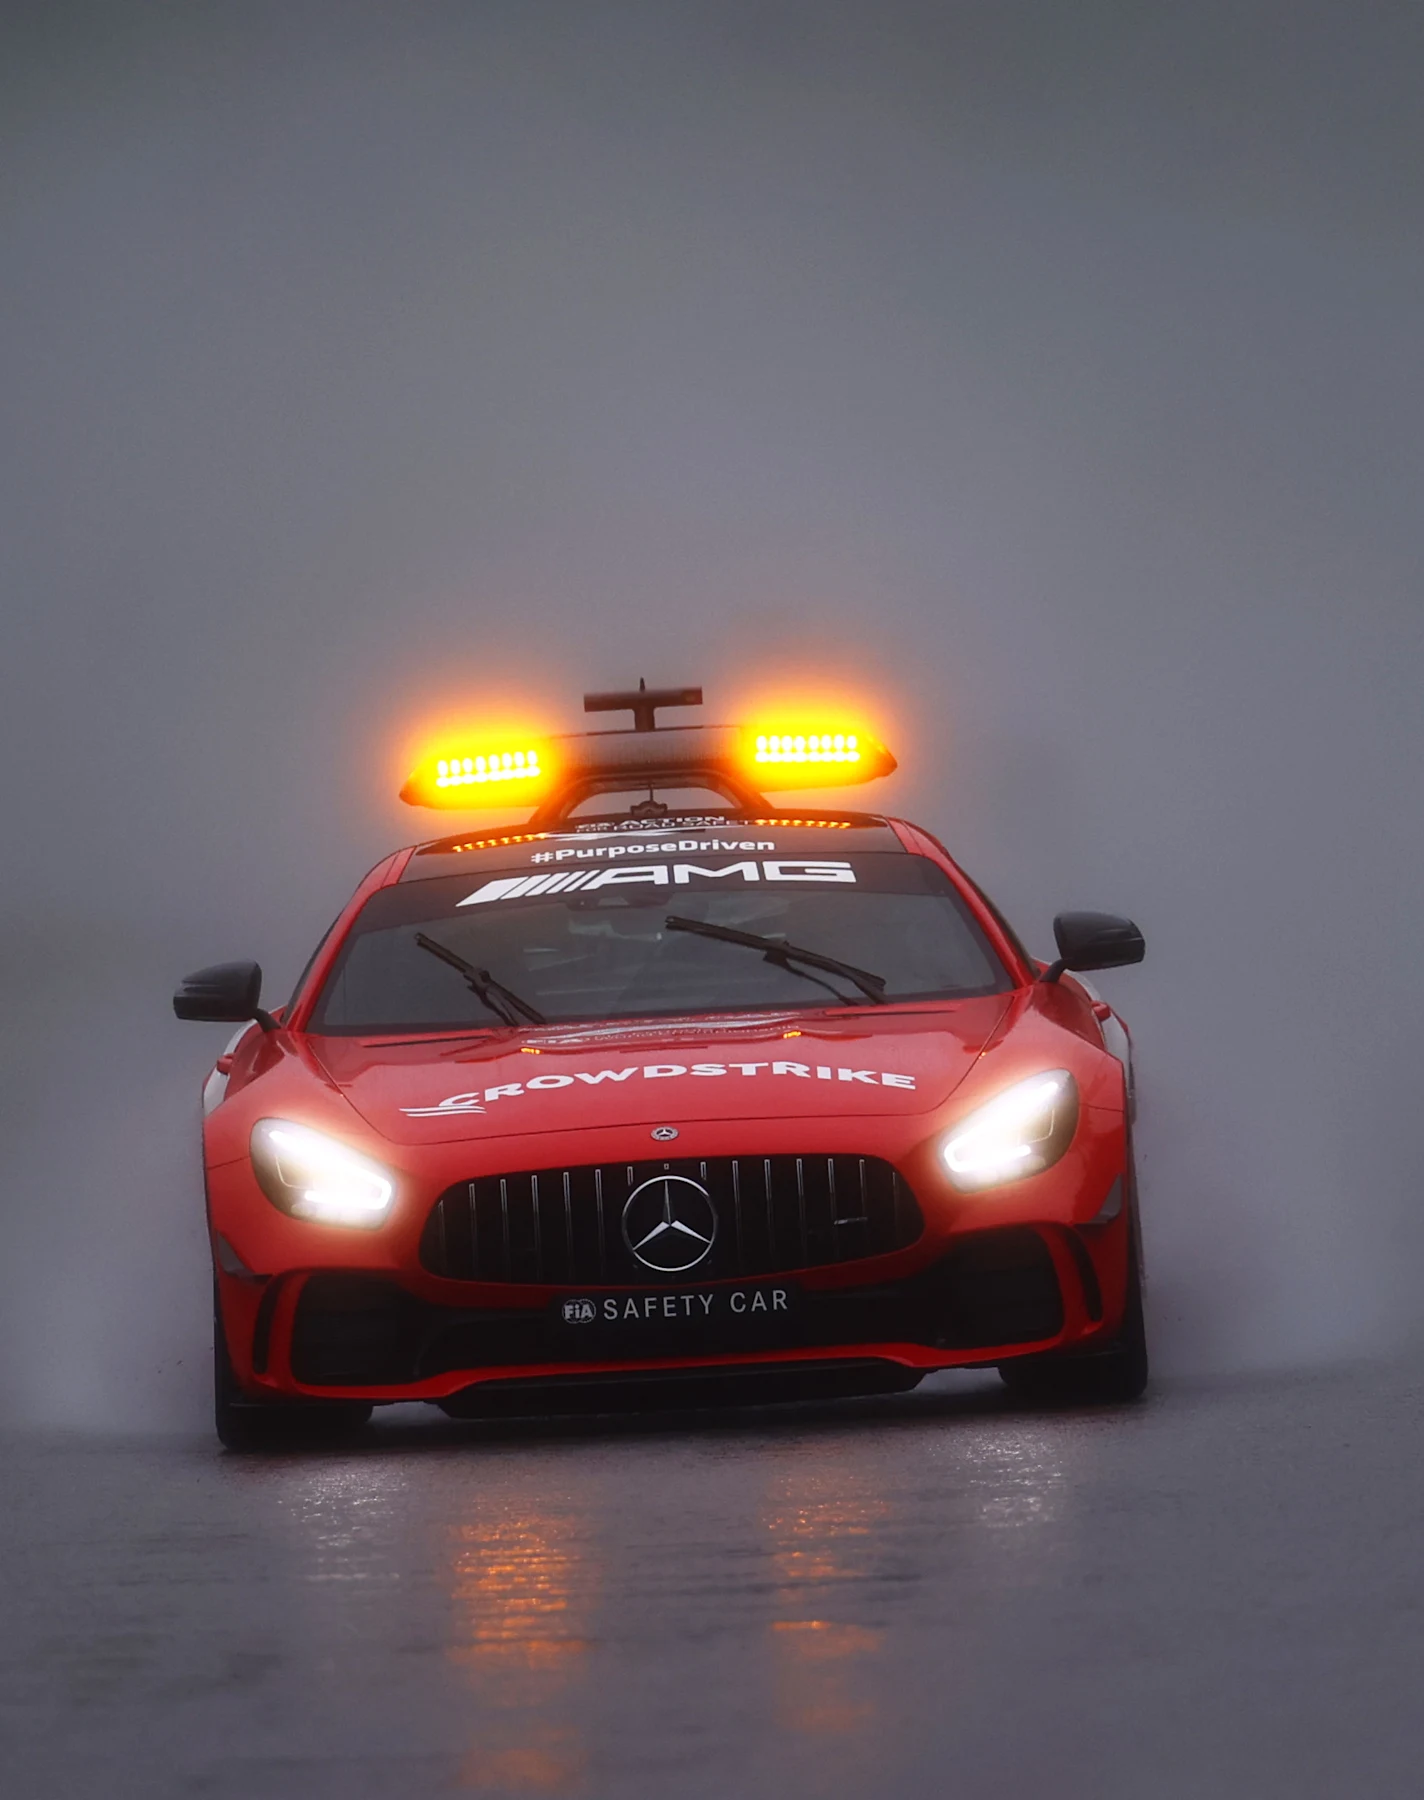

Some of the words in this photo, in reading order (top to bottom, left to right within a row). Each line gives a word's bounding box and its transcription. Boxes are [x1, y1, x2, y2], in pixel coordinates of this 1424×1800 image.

[531, 837, 775, 863] #PurposeDriven
[438, 1061, 917, 1108] CROWDSTRIKE
[603, 1293, 715, 1320] SAFETY
[729, 1289, 789, 1314] CAR
